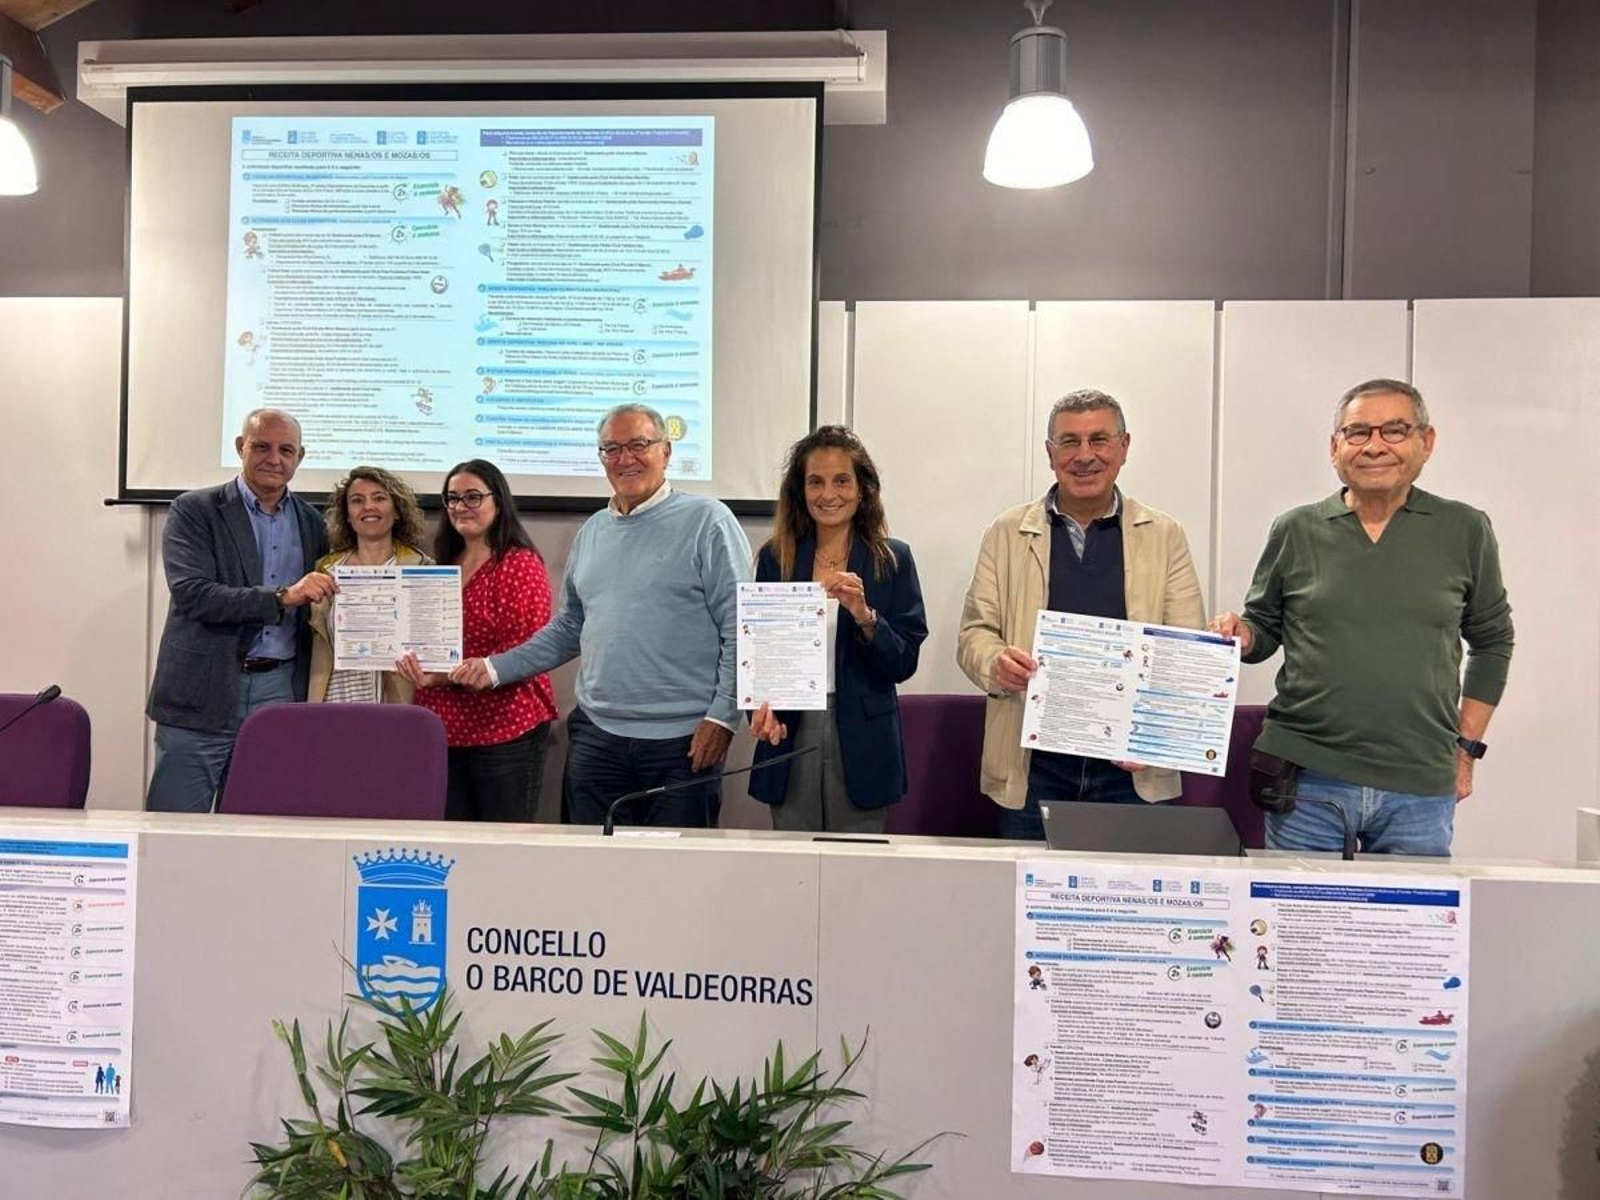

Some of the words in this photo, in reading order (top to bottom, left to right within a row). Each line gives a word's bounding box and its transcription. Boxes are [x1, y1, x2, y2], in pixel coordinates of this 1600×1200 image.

[1081, 895, 1120, 903] DEPORTIVA
[467, 927, 606, 959] CONCELLO
[466, 964, 483, 990] O
[493, 965, 583, 995] BARCO
[593, 969, 628, 997] DE
[634, 971, 813, 1006] VALDEORRAS
